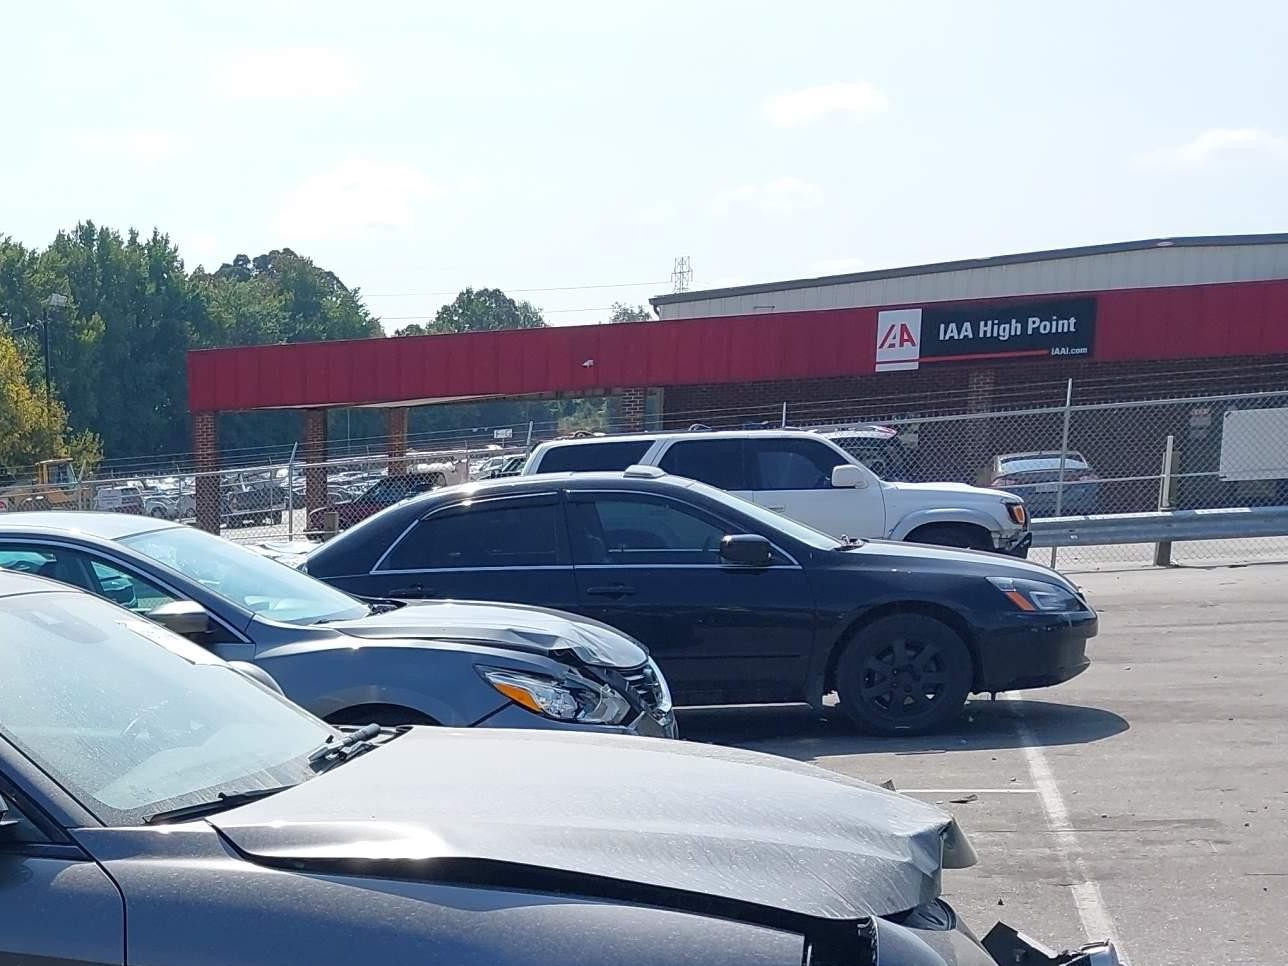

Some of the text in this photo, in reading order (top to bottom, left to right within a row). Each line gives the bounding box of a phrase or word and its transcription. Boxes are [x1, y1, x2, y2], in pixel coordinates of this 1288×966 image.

[939, 315, 1076, 340] IAA High Point
